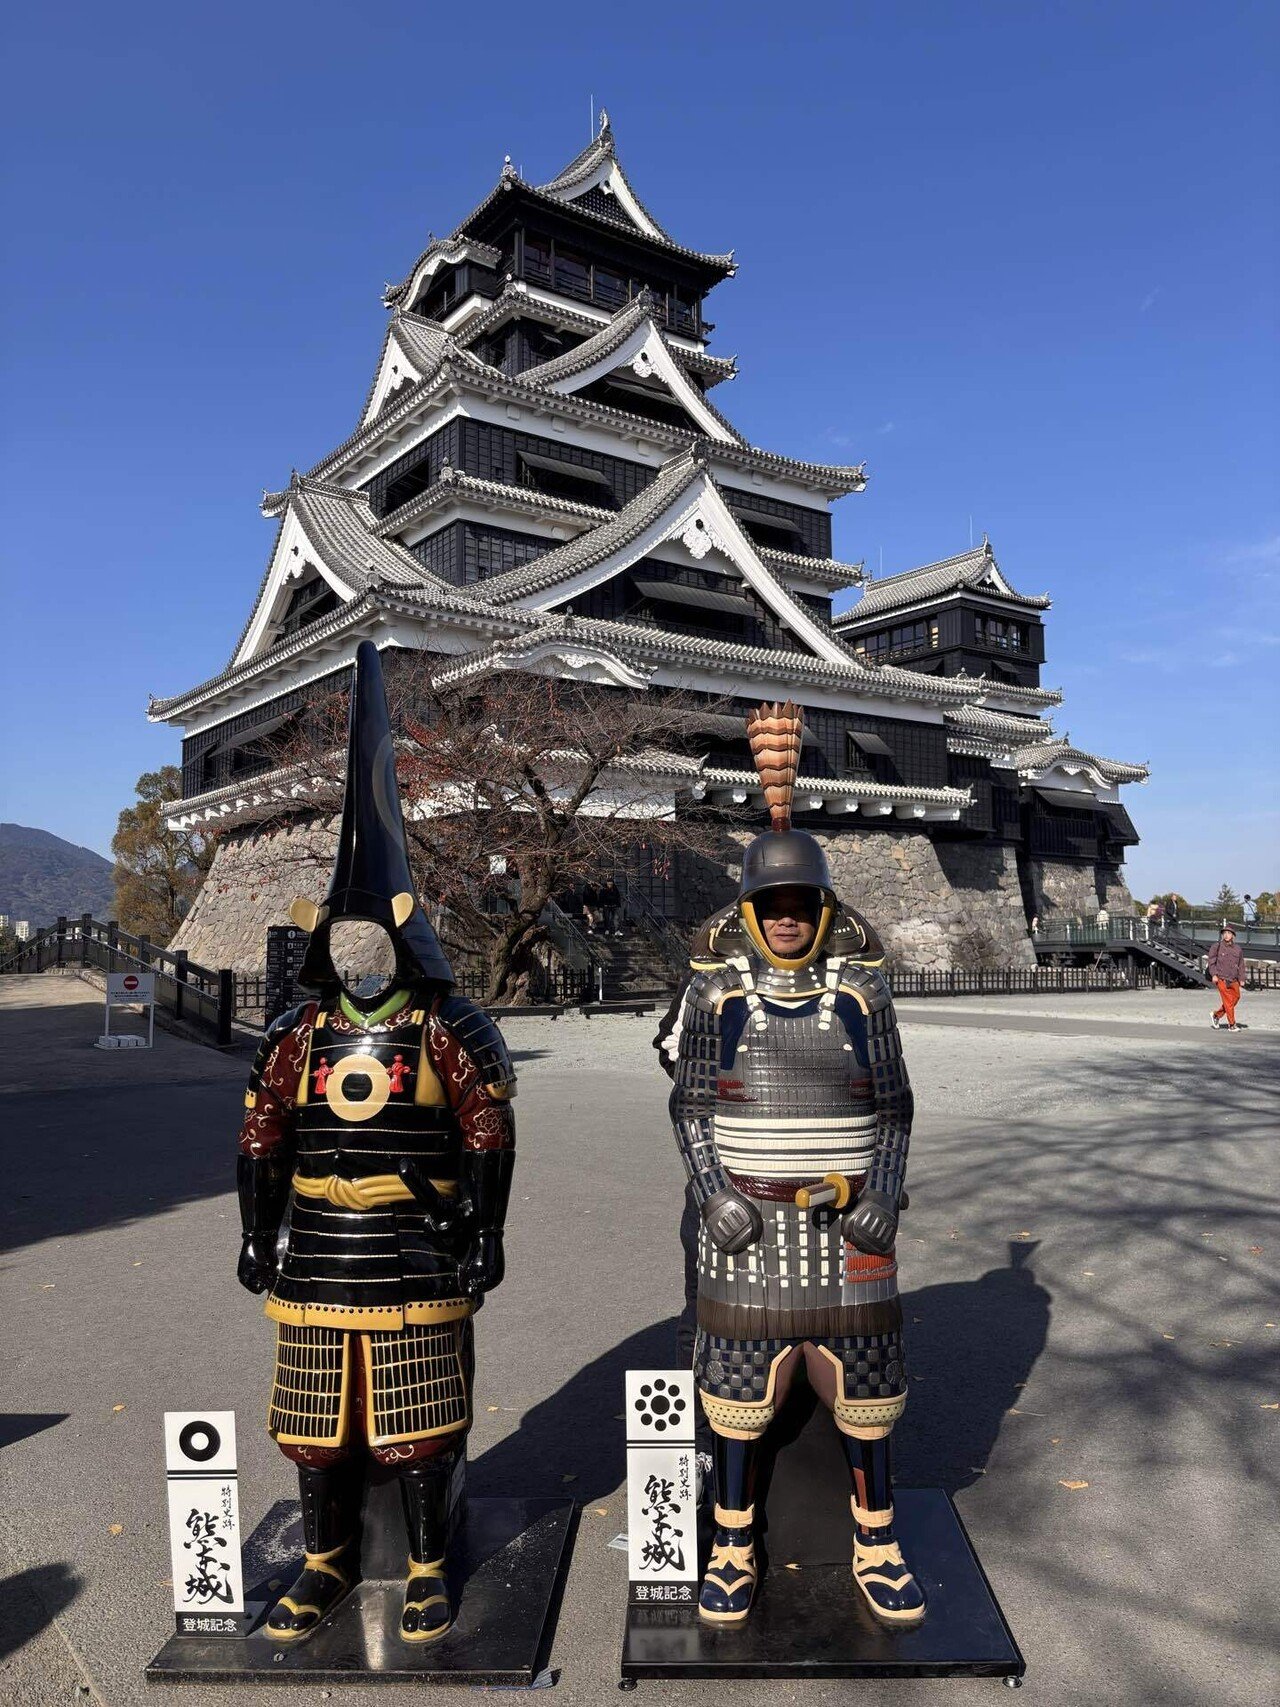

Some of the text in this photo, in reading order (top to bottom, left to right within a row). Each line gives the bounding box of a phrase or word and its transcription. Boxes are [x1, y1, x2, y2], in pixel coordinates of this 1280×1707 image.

[678, 1454, 693, 1500] 特別史跡
[221, 1485, 235, 1530] 特別史跡
[639, 1475, 686, 1572] 熊本城
[183, 1508, 234, 1604] 熊本城
[635, 1585, 692, 1601] 登城記念
[182, 1618, 237, 1632] 登城記念
